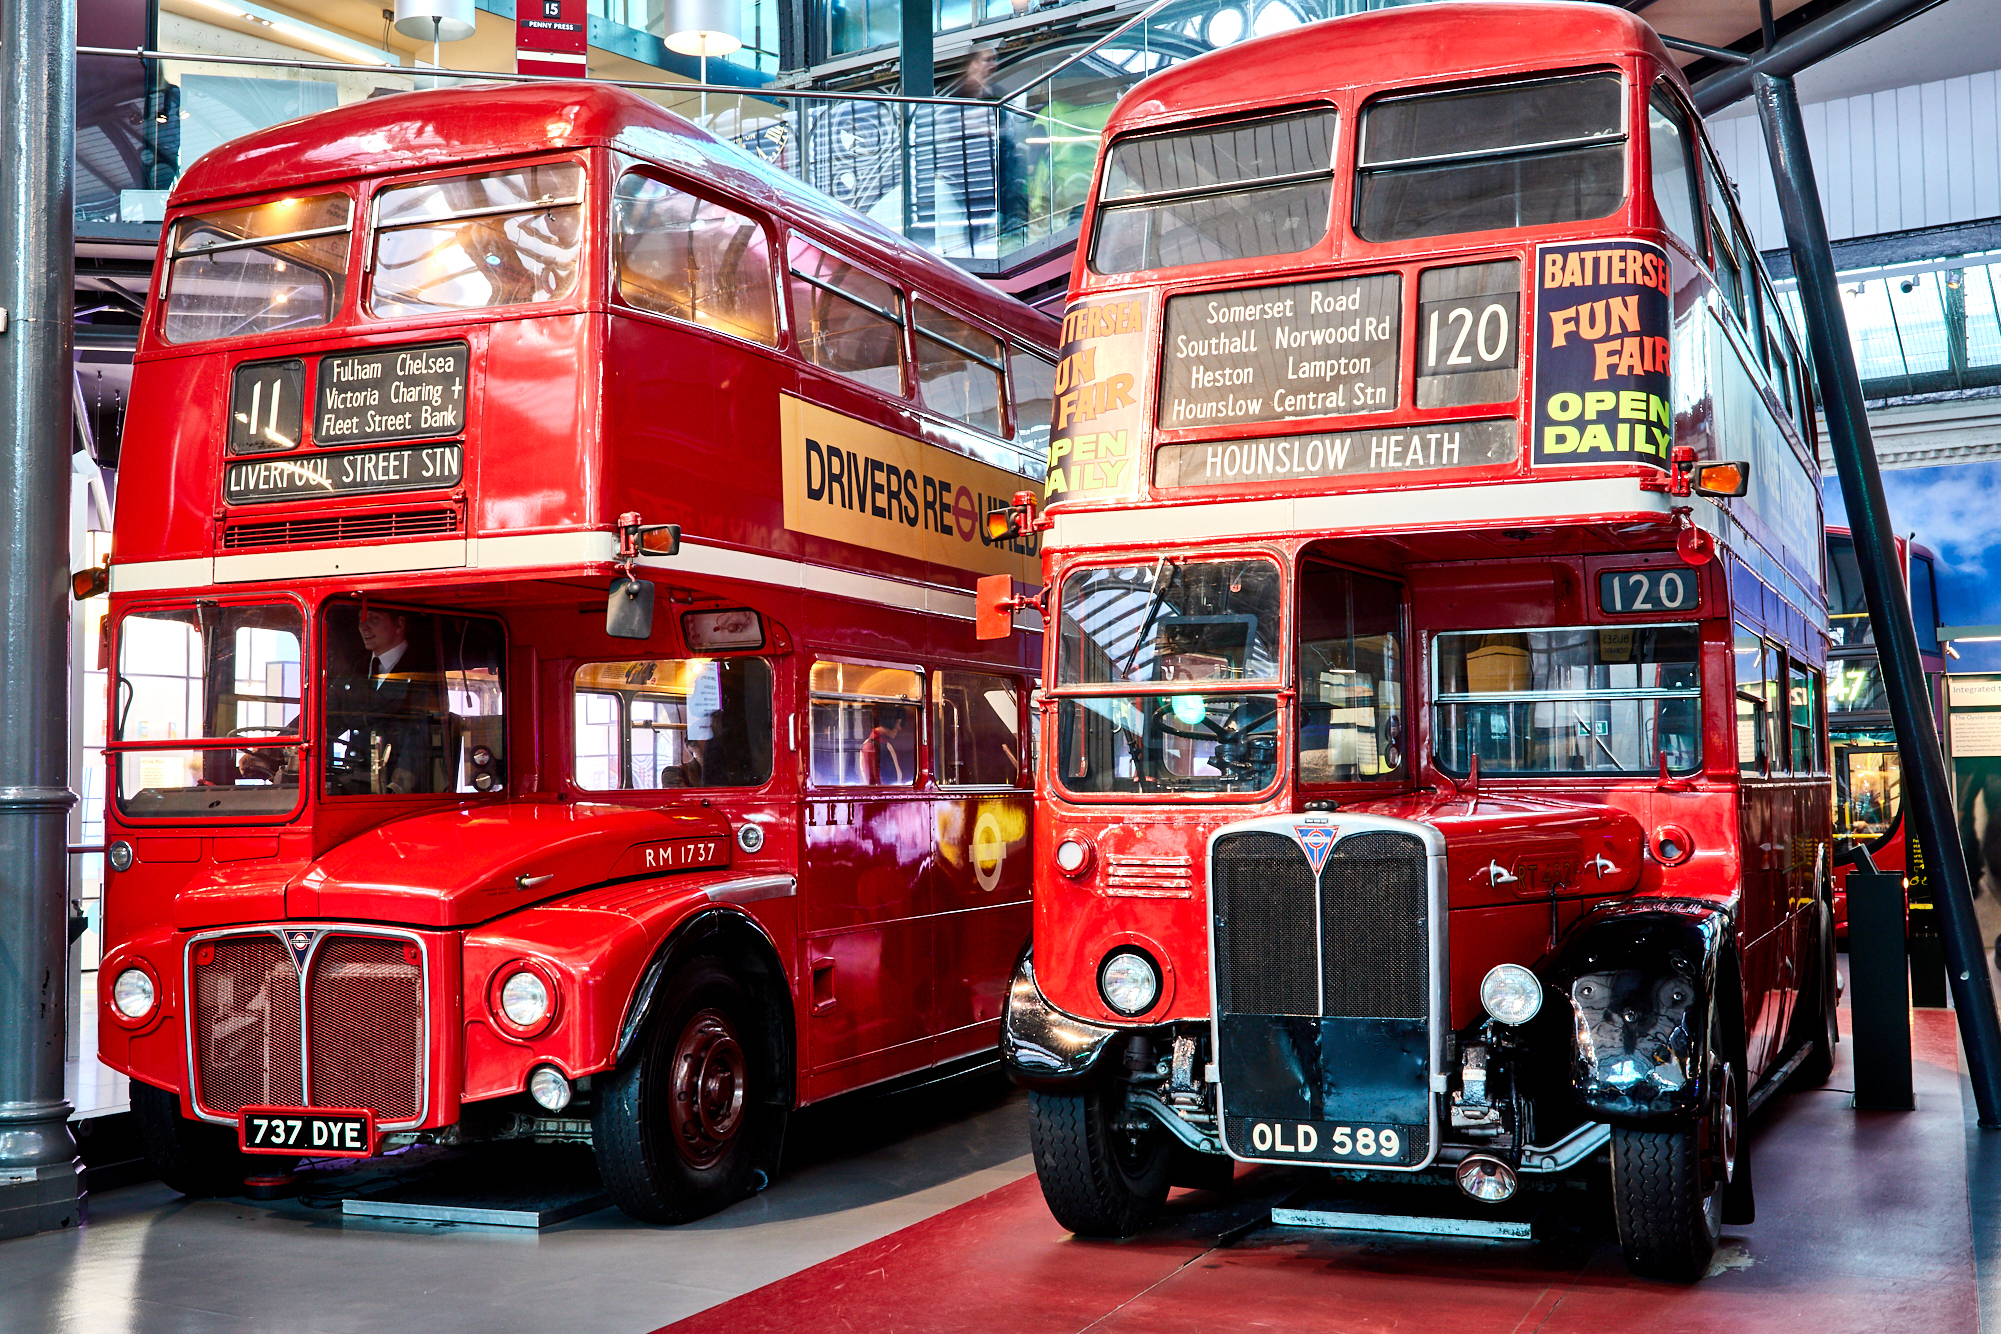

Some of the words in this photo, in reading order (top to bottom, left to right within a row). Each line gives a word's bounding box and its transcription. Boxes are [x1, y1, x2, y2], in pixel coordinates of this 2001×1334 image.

[529, 21, 552, 29] PENNY
[553, 23, 574, 31] PRESS
[545, 2, 559, 16] 15
[1206, 299, 1294, 324] Somerset
[1310, 287, 1361, 314] Road
[1549, 295, 1641, 348] FUN
[1176, 329, 1257, 358] Southall
[1275, 319, 1360, 350] Norwood
[1365, 316, 1390, 341] Rd
[1427, 303, 1509, 367] 120
[333, 358, 382, 383] Fulham
[396, 352, 455, 376] Chelsea
[1191, 366, 1254, 388] Heston
[1288, 356, 1371, 382] Lampton
[1593, 335, 1671, 381] FAIR
[249, 378, 281, 434] 11
[326, 387, 379, 410] Victoria
[390, 381, 443, 407] Charing
[1057, 373, 1137, 431] FAIR
[1173, 394, 1263, 421] Hounslow
[1273, 385, 1346, 412] Central
[1353, 382, 1387, 406] Stn
[1547, 390, 1670, 430] OPEN
[322, 414, 359, 436] Fleet
[364, 410, 412, 433] Street
[421, 405, 457, 428] Bank
[1205, 438, 1351, 477] HOUNSLOW
[1370, 431, 1460, 468] HEATH
[1543, 422, 1671, 460] DAILY
[230, 458, 332, 491] LIVERPOOL
[342, 450, 412, 483] STREET
[421, 447, 458, 478] STN
[805, 438, 919, 527] DRIVERS
[1044, 459, 1129, 500] AILY
[1612, 572, 1684, 611] 120
[1953, 685, 1996, 694] Integrated
[645, 846, 673, 868] RM
[681, 843, 715, 864] 1737
[1518, 864, 1538, 890] RT
[253, 1118, 303, 1145] 737
[312, 1120, 361, 1148] DYE
[1252, 1122, 1318, 1153] OLD
[1332, 1126, 1400, 1158] 589
